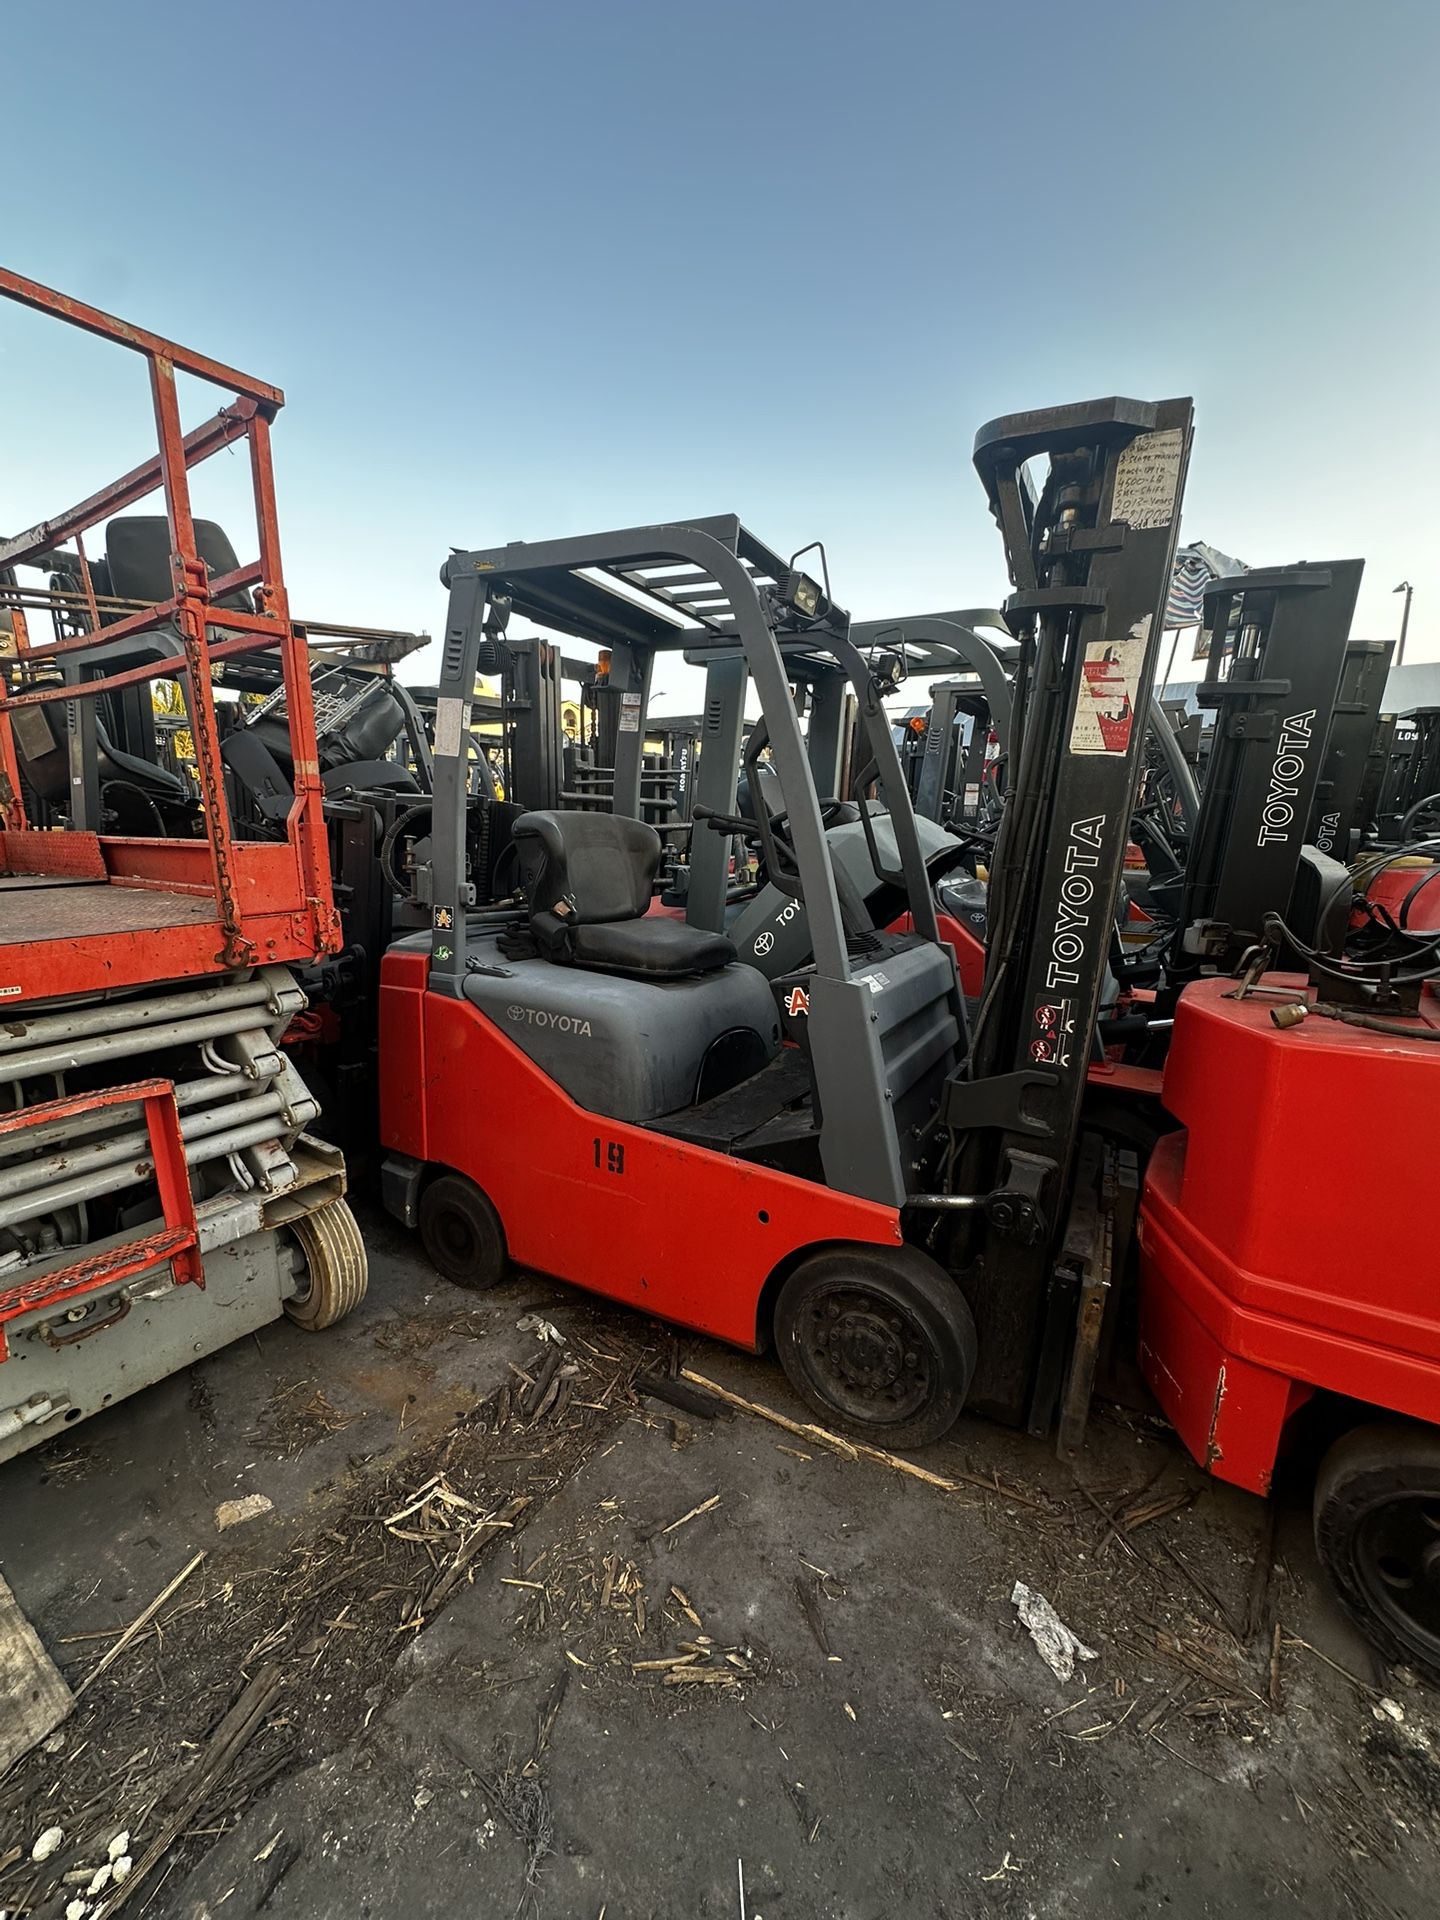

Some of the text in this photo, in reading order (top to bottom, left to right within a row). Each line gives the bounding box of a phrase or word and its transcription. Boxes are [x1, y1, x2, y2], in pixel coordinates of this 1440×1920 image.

[1257, 708, 1317, 847] TOYOTA
[1316, 812, 1341, 852] OTA
[775, 898, 801, 927] TOY
[1045, 814, 1106, 989] TOYOTA
[784, 987, 810, 1016] SA
[525, 1008, 592, 1037] TOYOTA
[593, 1137, 625, 1175] 19
